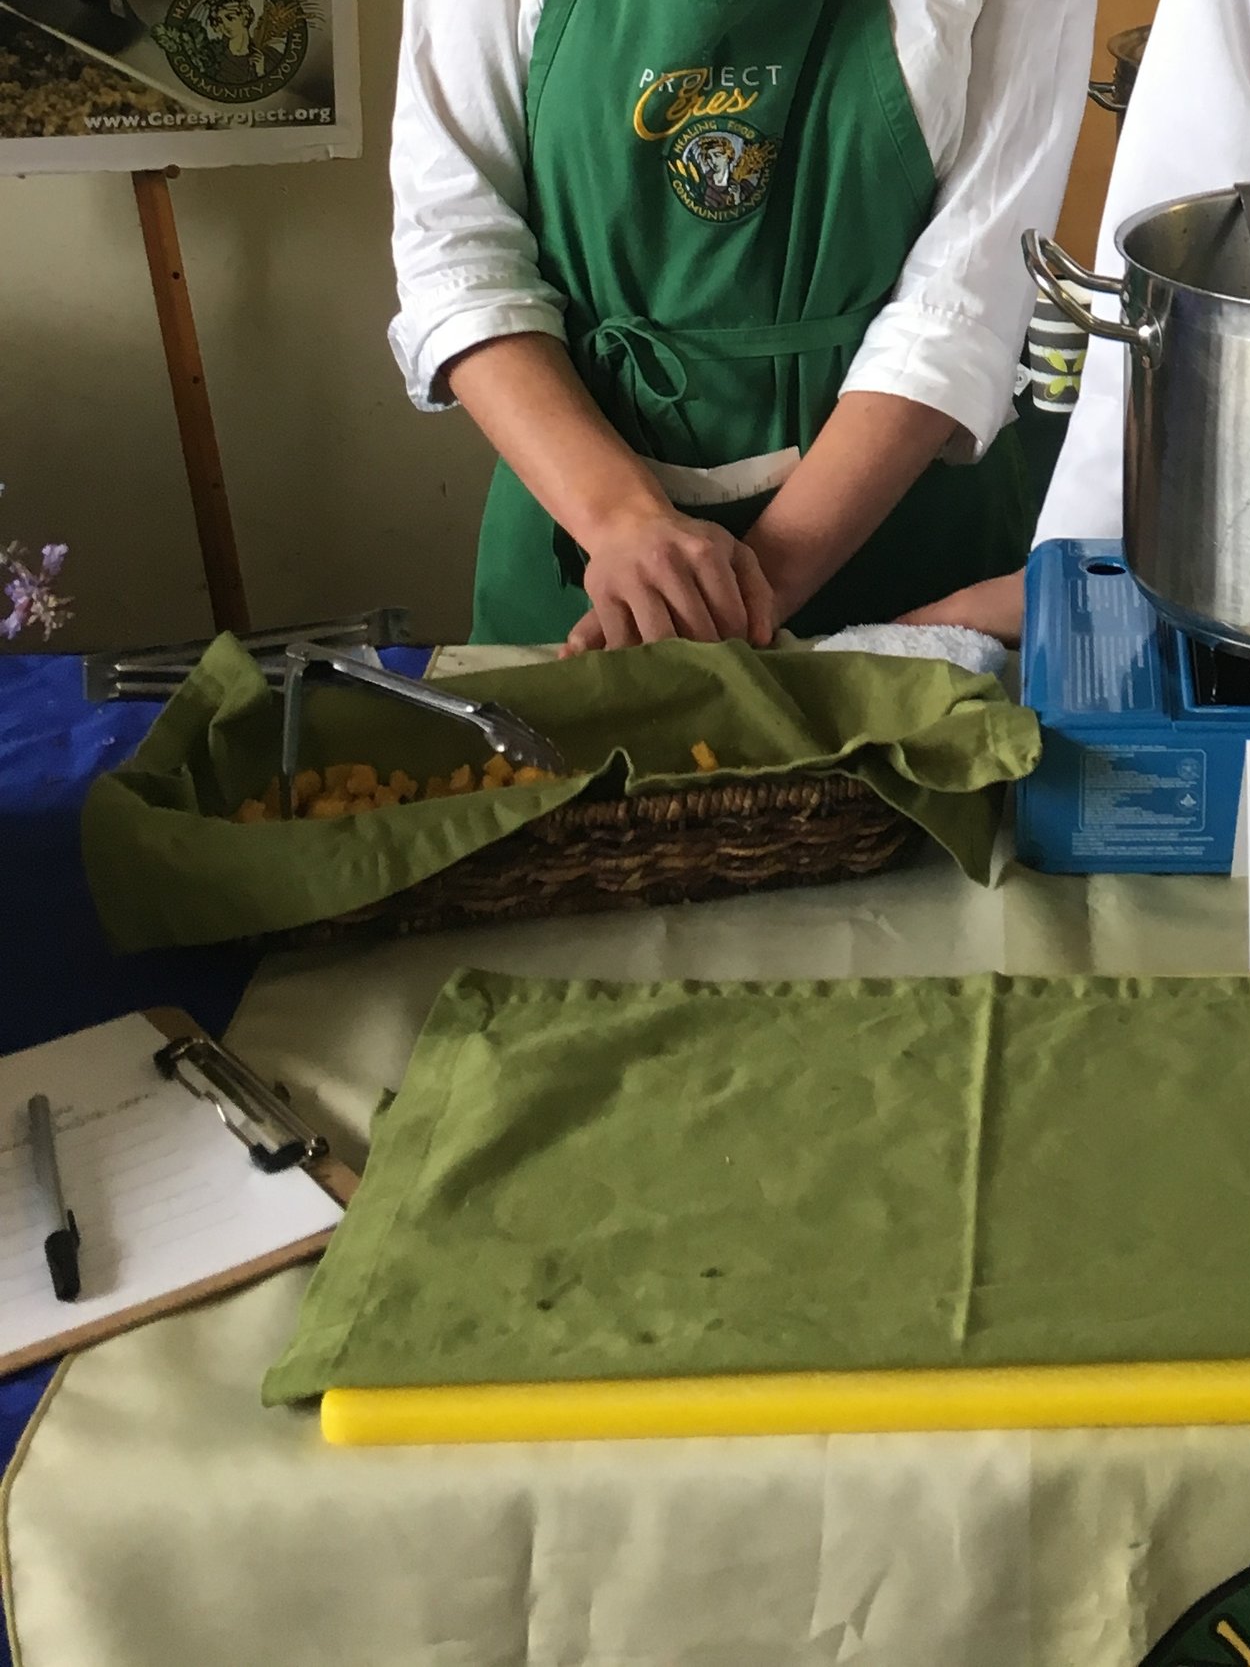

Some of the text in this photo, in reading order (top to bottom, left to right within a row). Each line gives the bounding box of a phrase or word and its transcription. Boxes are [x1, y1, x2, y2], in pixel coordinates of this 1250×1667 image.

[174, 32, 303, 98] COMMUNITY YOUTH
[639, 65, 782, 93] PROJECT
[84, 107, 332, 128] www.CeresProject.org
